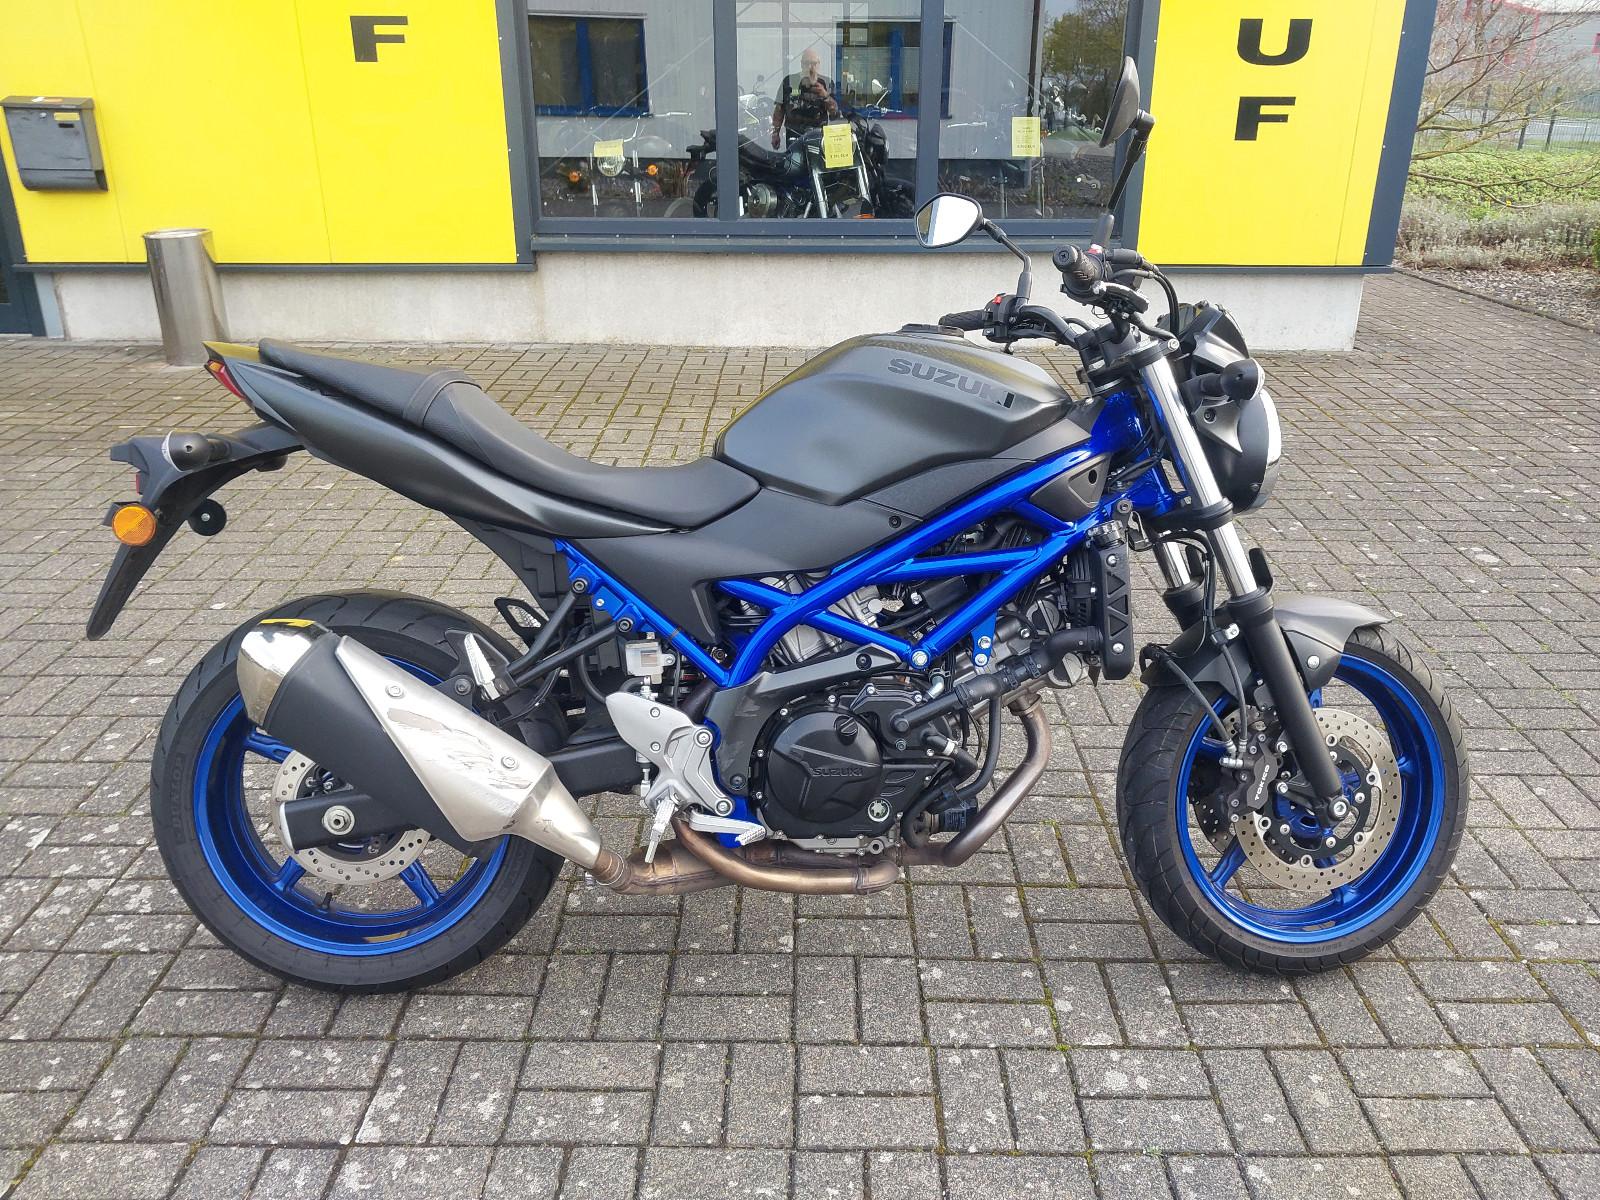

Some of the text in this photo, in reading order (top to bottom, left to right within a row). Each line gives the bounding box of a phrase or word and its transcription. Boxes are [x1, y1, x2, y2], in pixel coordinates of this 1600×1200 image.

[350, 16, 409, 62] F
[887, 358, 1016, 409] SUZUKI
[812, 767, 863, 777] SUZUKI
[1254, 764, 1270, 801] TOKICO
